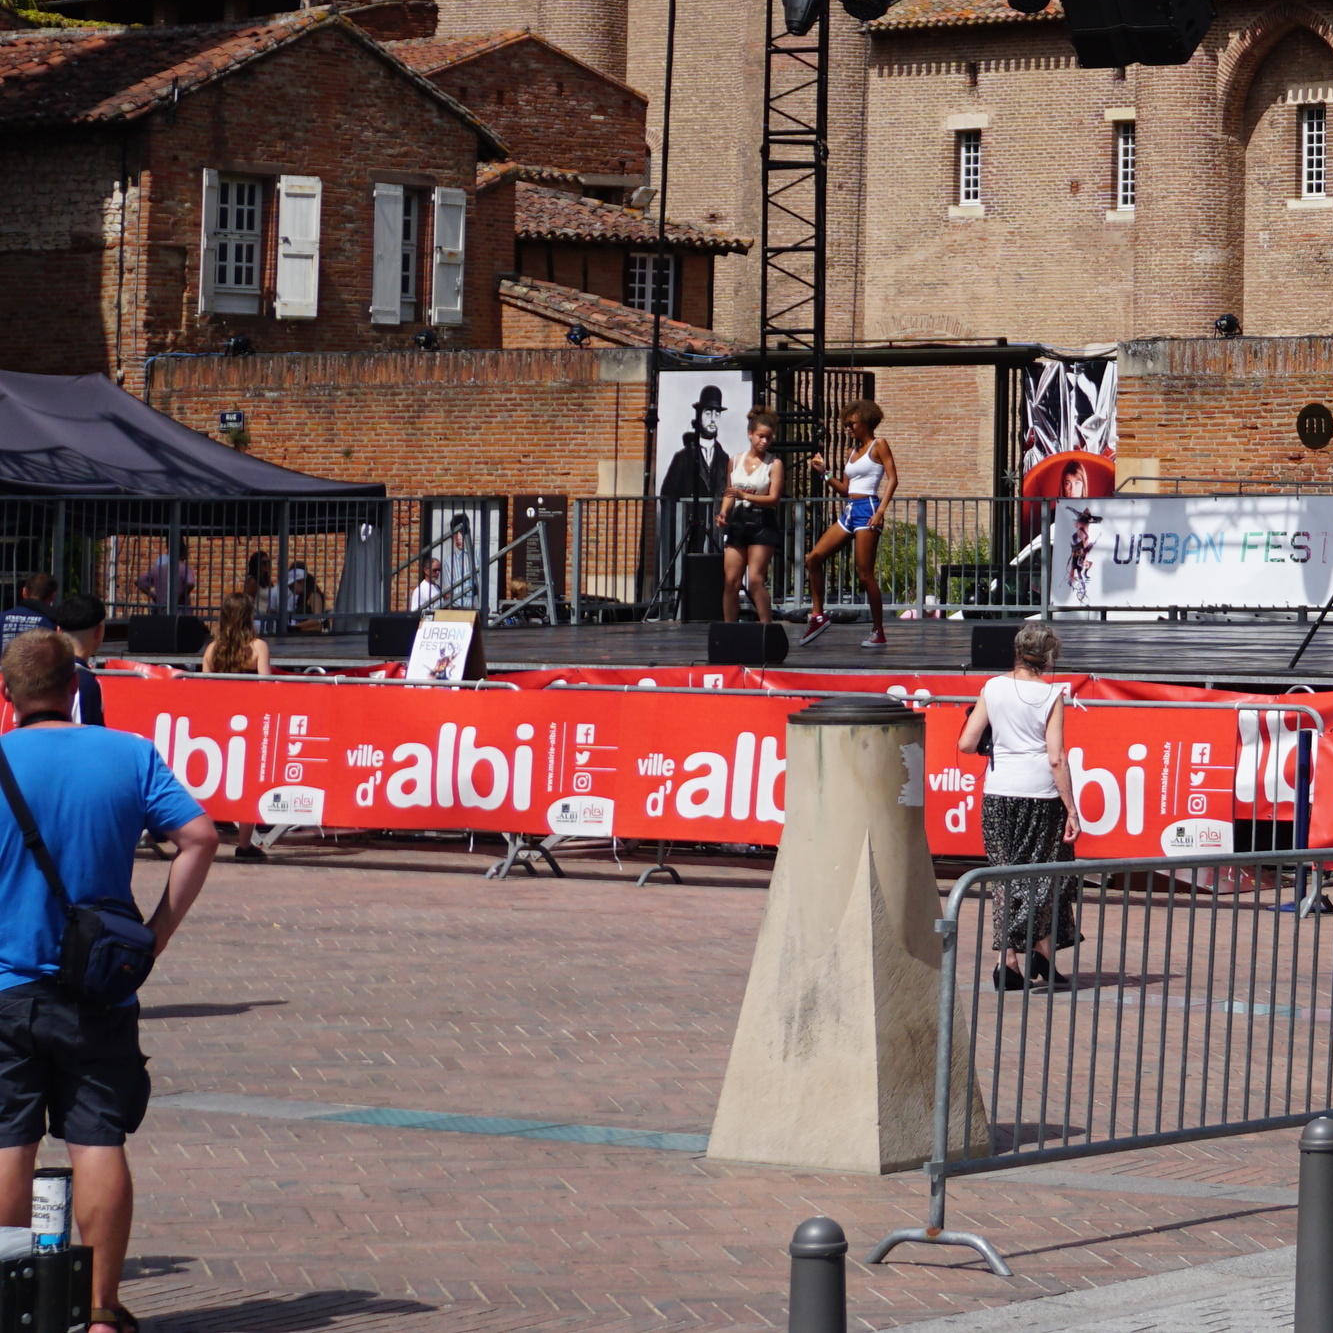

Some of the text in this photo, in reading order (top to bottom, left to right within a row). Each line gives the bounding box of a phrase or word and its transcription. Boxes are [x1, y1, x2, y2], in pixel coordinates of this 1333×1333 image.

[1112, 531, 1224, 565] URBAN
[422, 627, 465, 640] URBAN
[155, 712, 248, 801] lbi
[346, 744, 384, 767] ville
[355, 722, 535, 811] d' albi
[637, 752, 675, 777] ville
[645, 731, 787, 824] d' alb
[928, 767, 975, 792] ville
[1160, 741, 1172, 815] www.mairie-albi.fr
[944, 743, 1147, 836] d' bi
